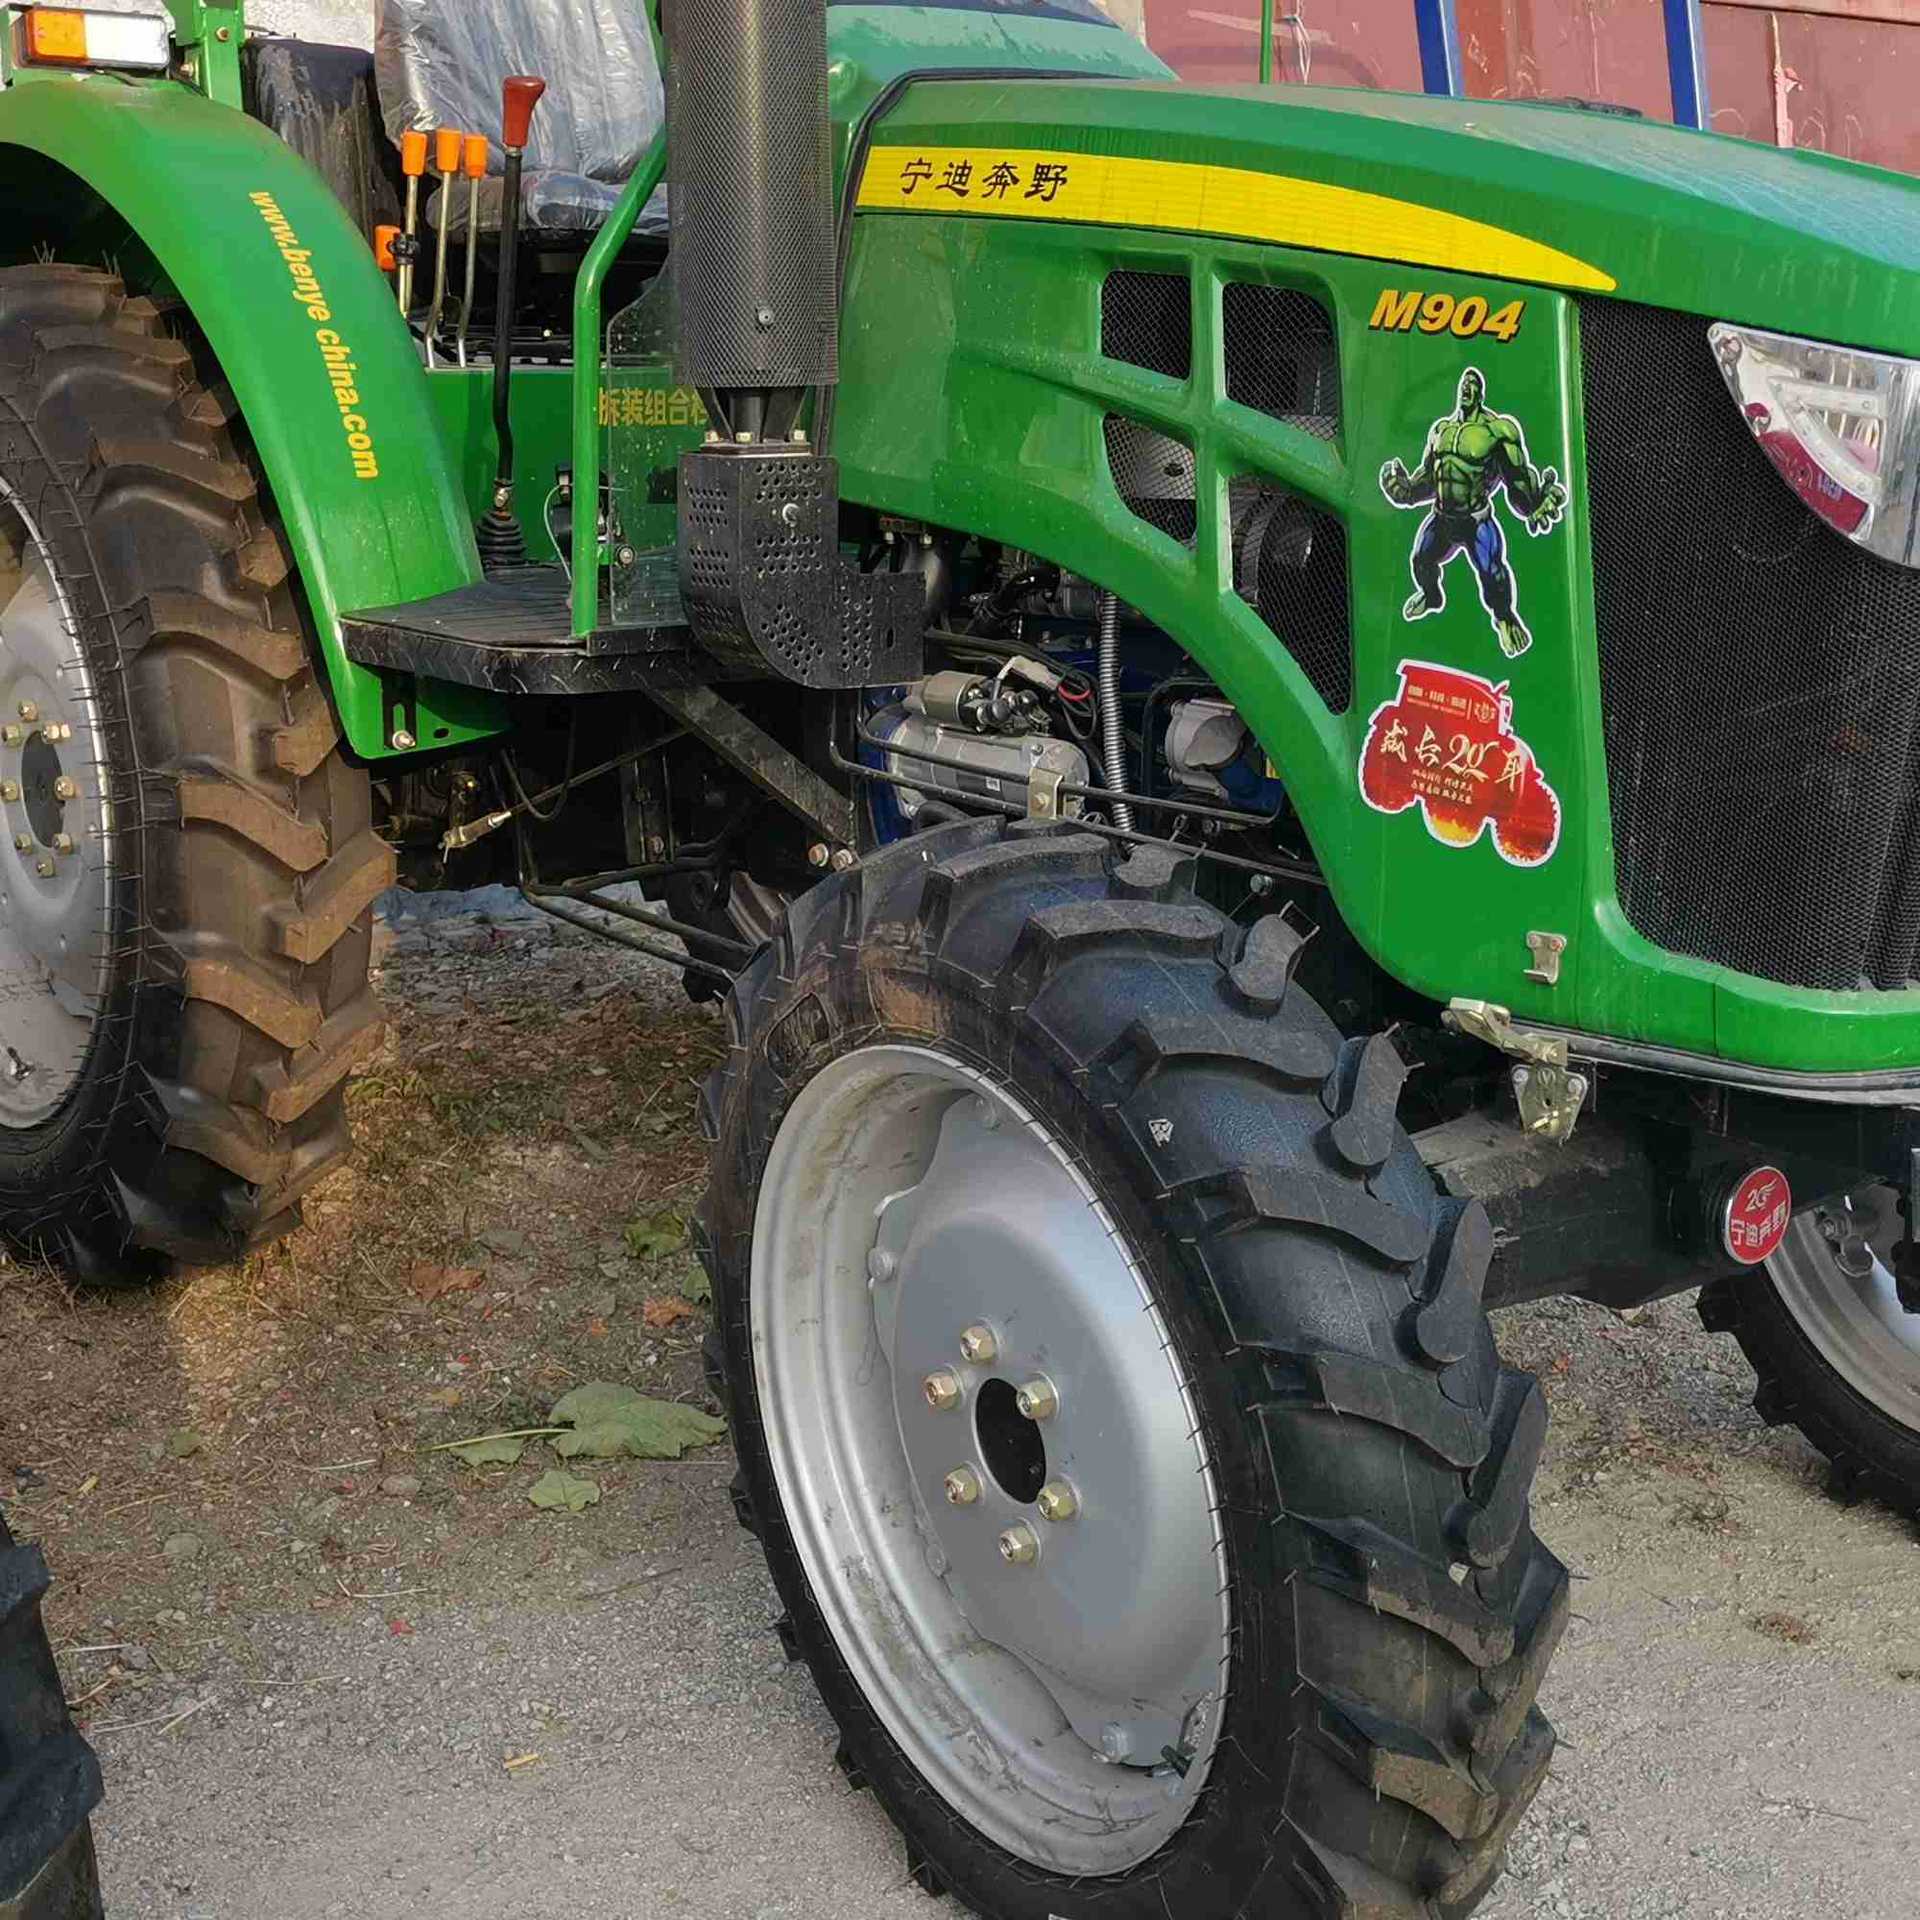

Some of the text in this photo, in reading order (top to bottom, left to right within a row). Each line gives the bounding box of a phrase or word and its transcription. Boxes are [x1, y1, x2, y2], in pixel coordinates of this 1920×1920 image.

[900, 157, 1068, 202] 宁迪奔野
[1368, 289, 1526, 343] M904
